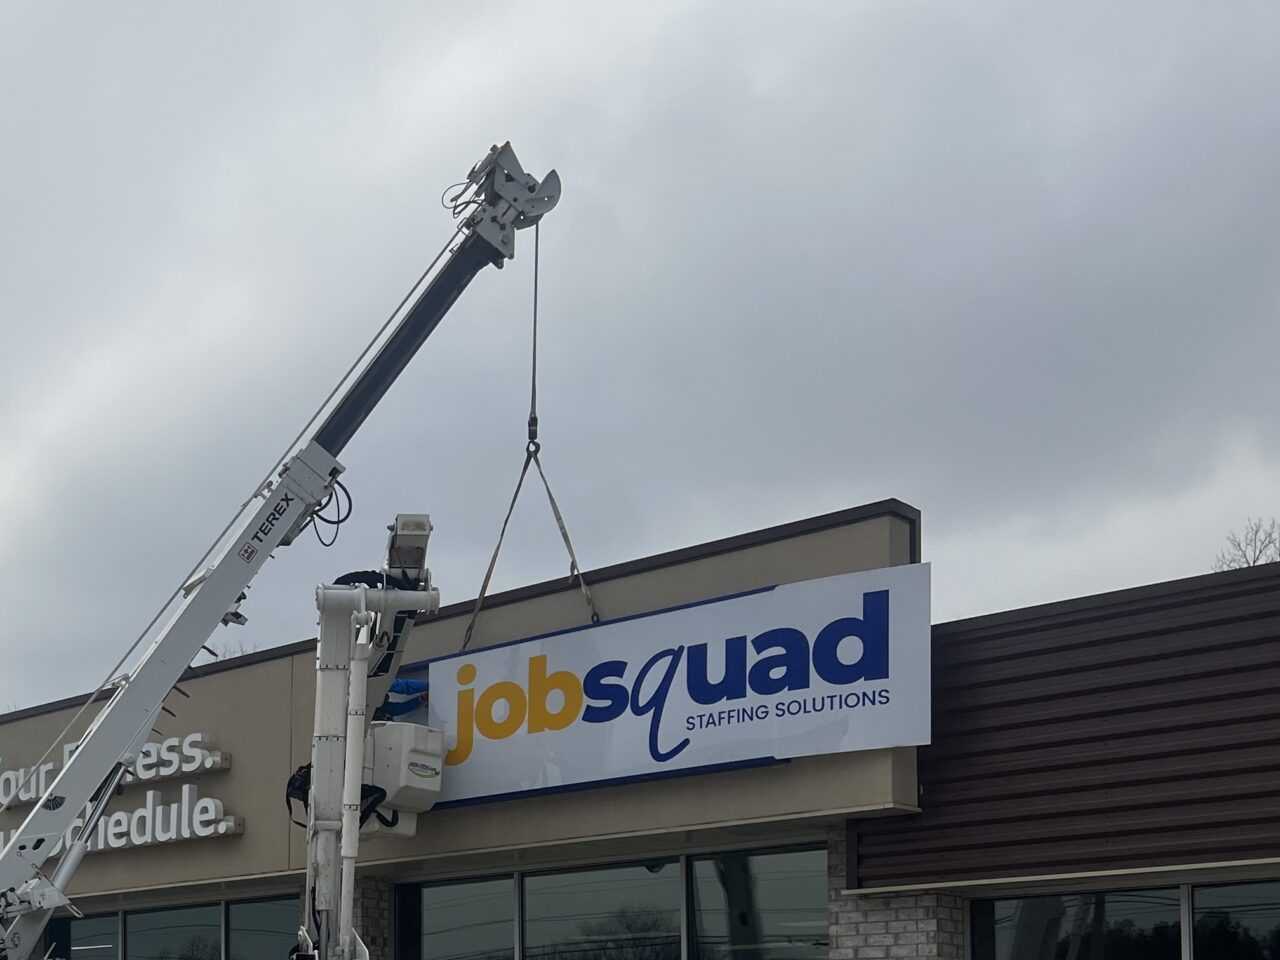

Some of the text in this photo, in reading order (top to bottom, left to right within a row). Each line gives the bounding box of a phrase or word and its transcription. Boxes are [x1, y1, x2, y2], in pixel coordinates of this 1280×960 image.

[251, 492, 295, 543] TEREX
[444, 589, 890, 763] jobsquad
[686, 689, 891, 731] STAFFING SOLUTIONS
[48, 784, 228, 857] chedule.
